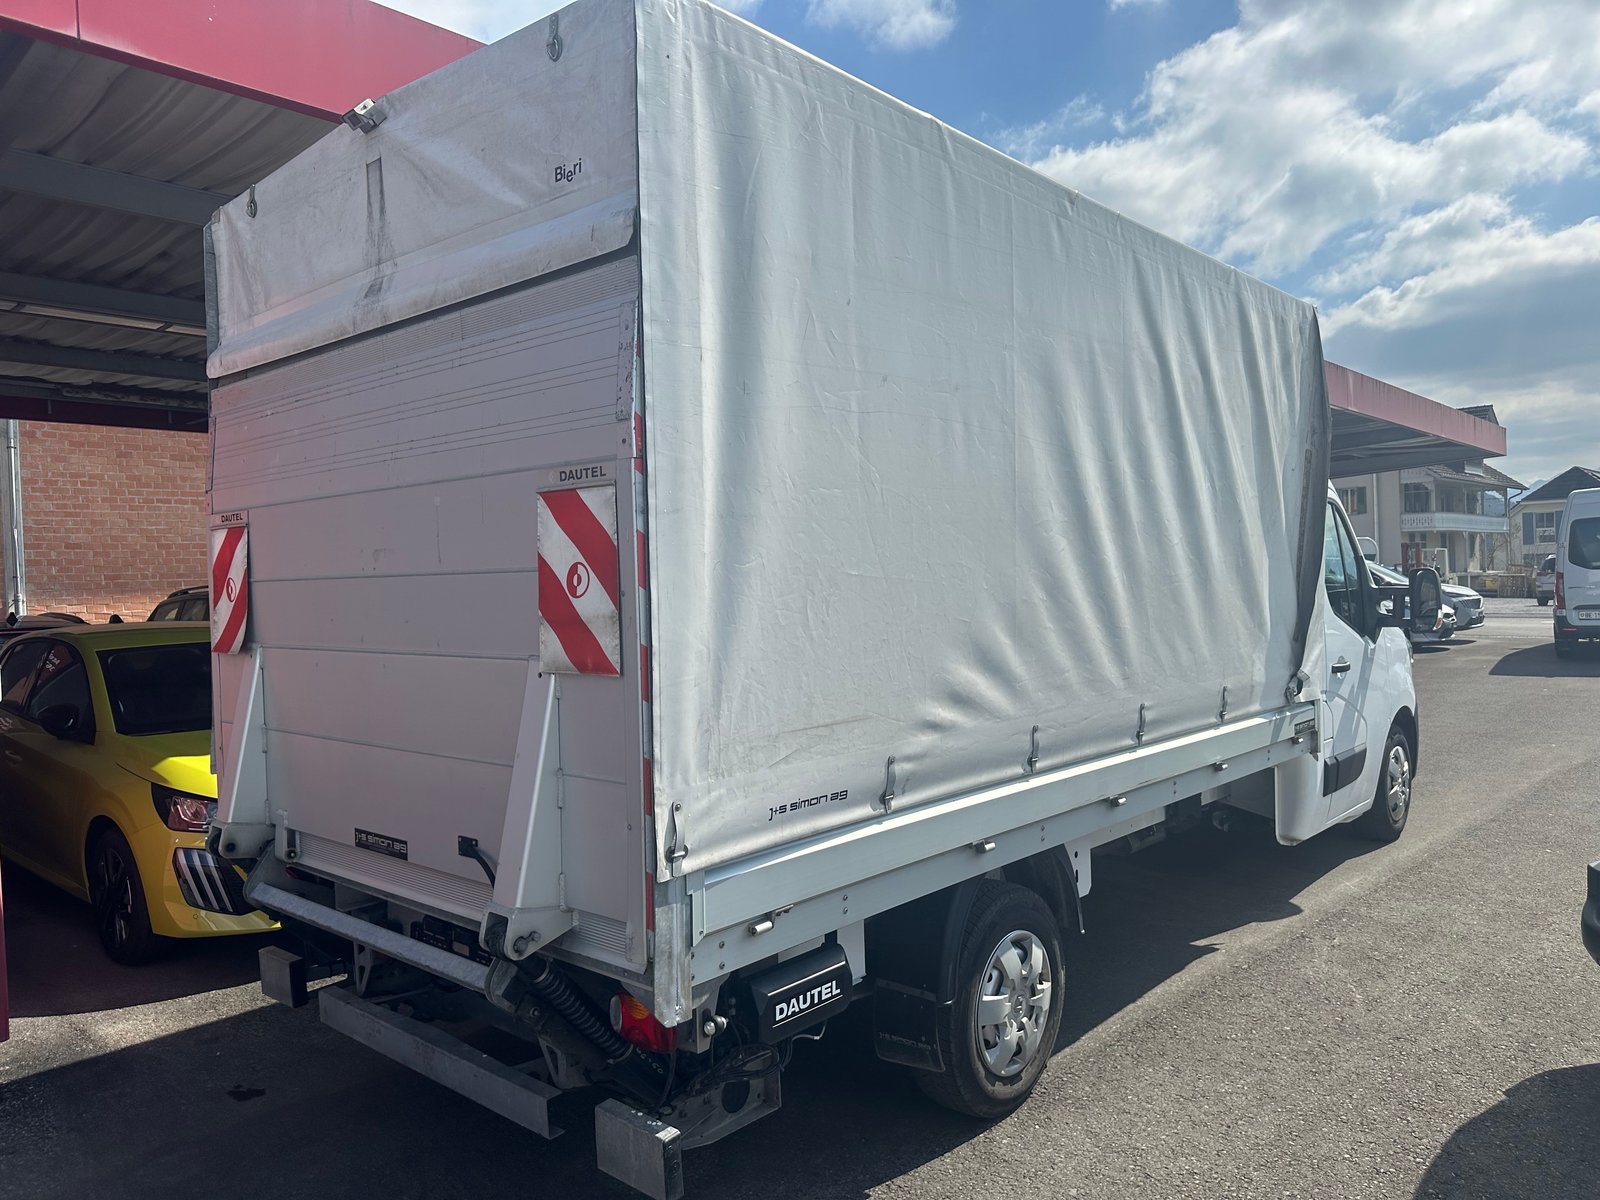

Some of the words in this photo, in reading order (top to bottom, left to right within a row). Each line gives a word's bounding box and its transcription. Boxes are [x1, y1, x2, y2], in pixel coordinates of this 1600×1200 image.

[555, 158, 582, 183] Bieri
[559, 466, 606, 482] DAUTEL
[221, 513, 243, 523] DAUTEL
[768, 804, 788, 822] j+s
[789, 794, 828, 811] simon
[830, 790, 848, 801] ag
[367, 834, 393, 848] simon
[775, 980, 841, 1022] DAUTEL
